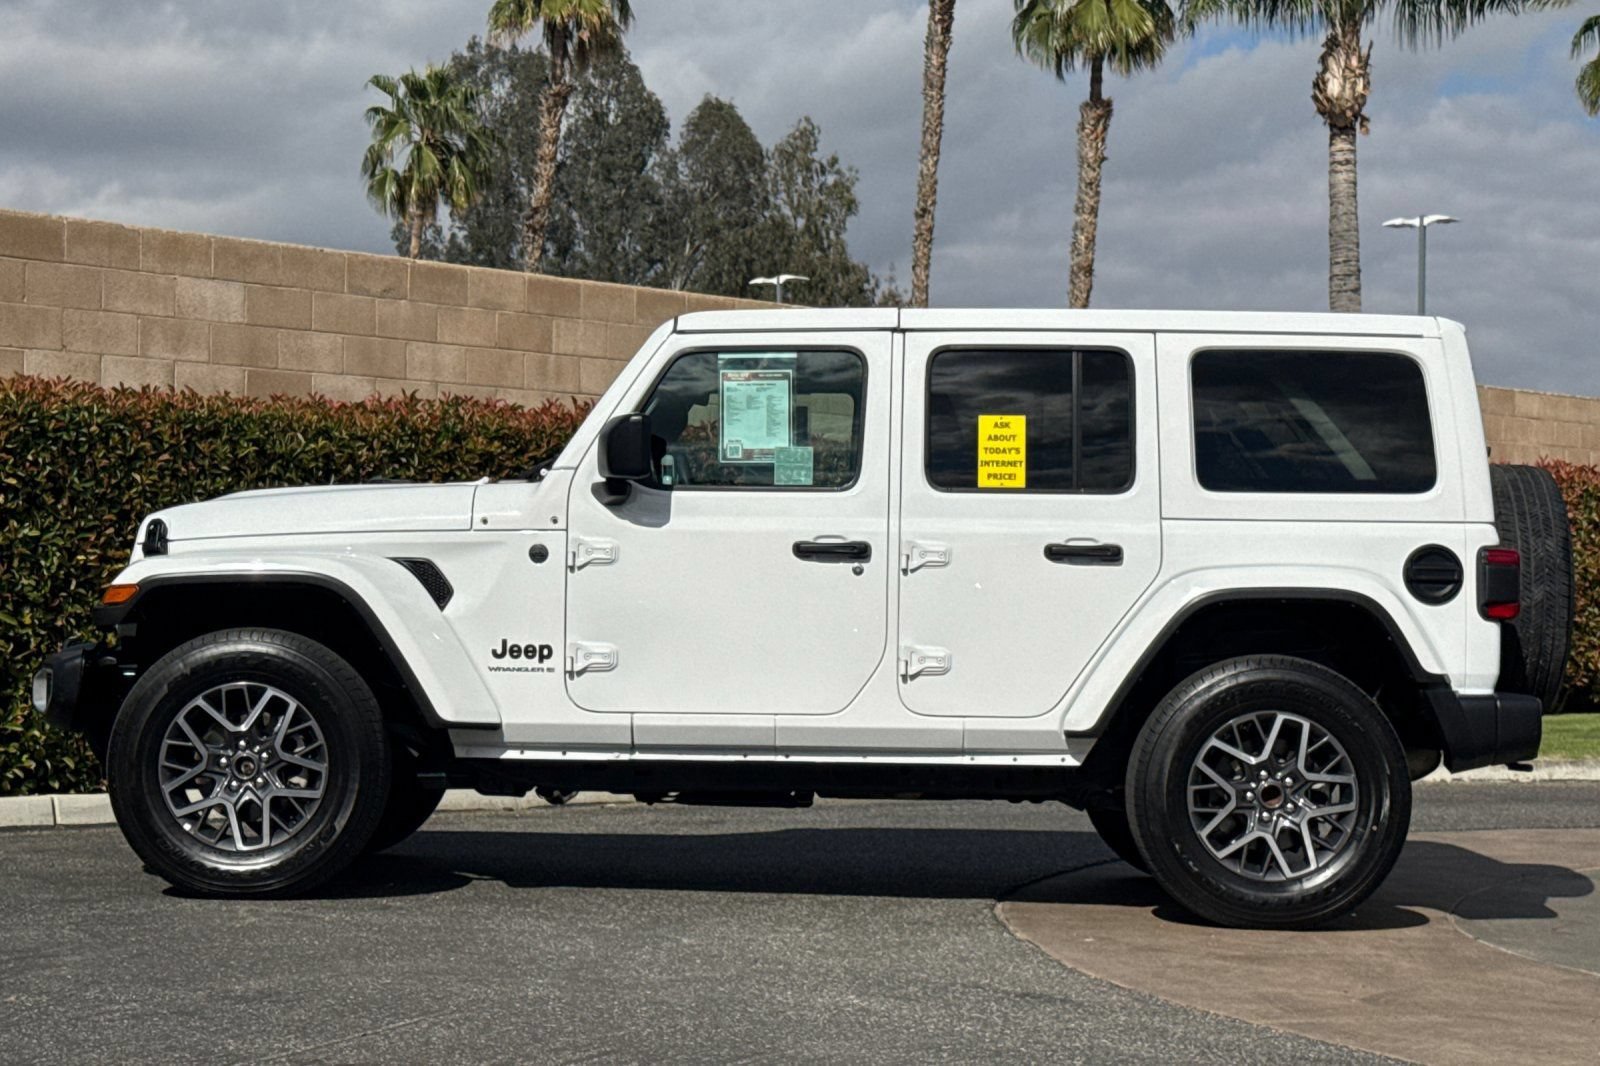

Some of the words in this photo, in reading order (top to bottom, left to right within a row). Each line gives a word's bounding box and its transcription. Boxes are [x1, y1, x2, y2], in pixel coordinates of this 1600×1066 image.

[993, 421, 1011, 429] ASK
[987, 434, 1017, 442] ABOUT
[491, 638, 553, 664] Jeep
